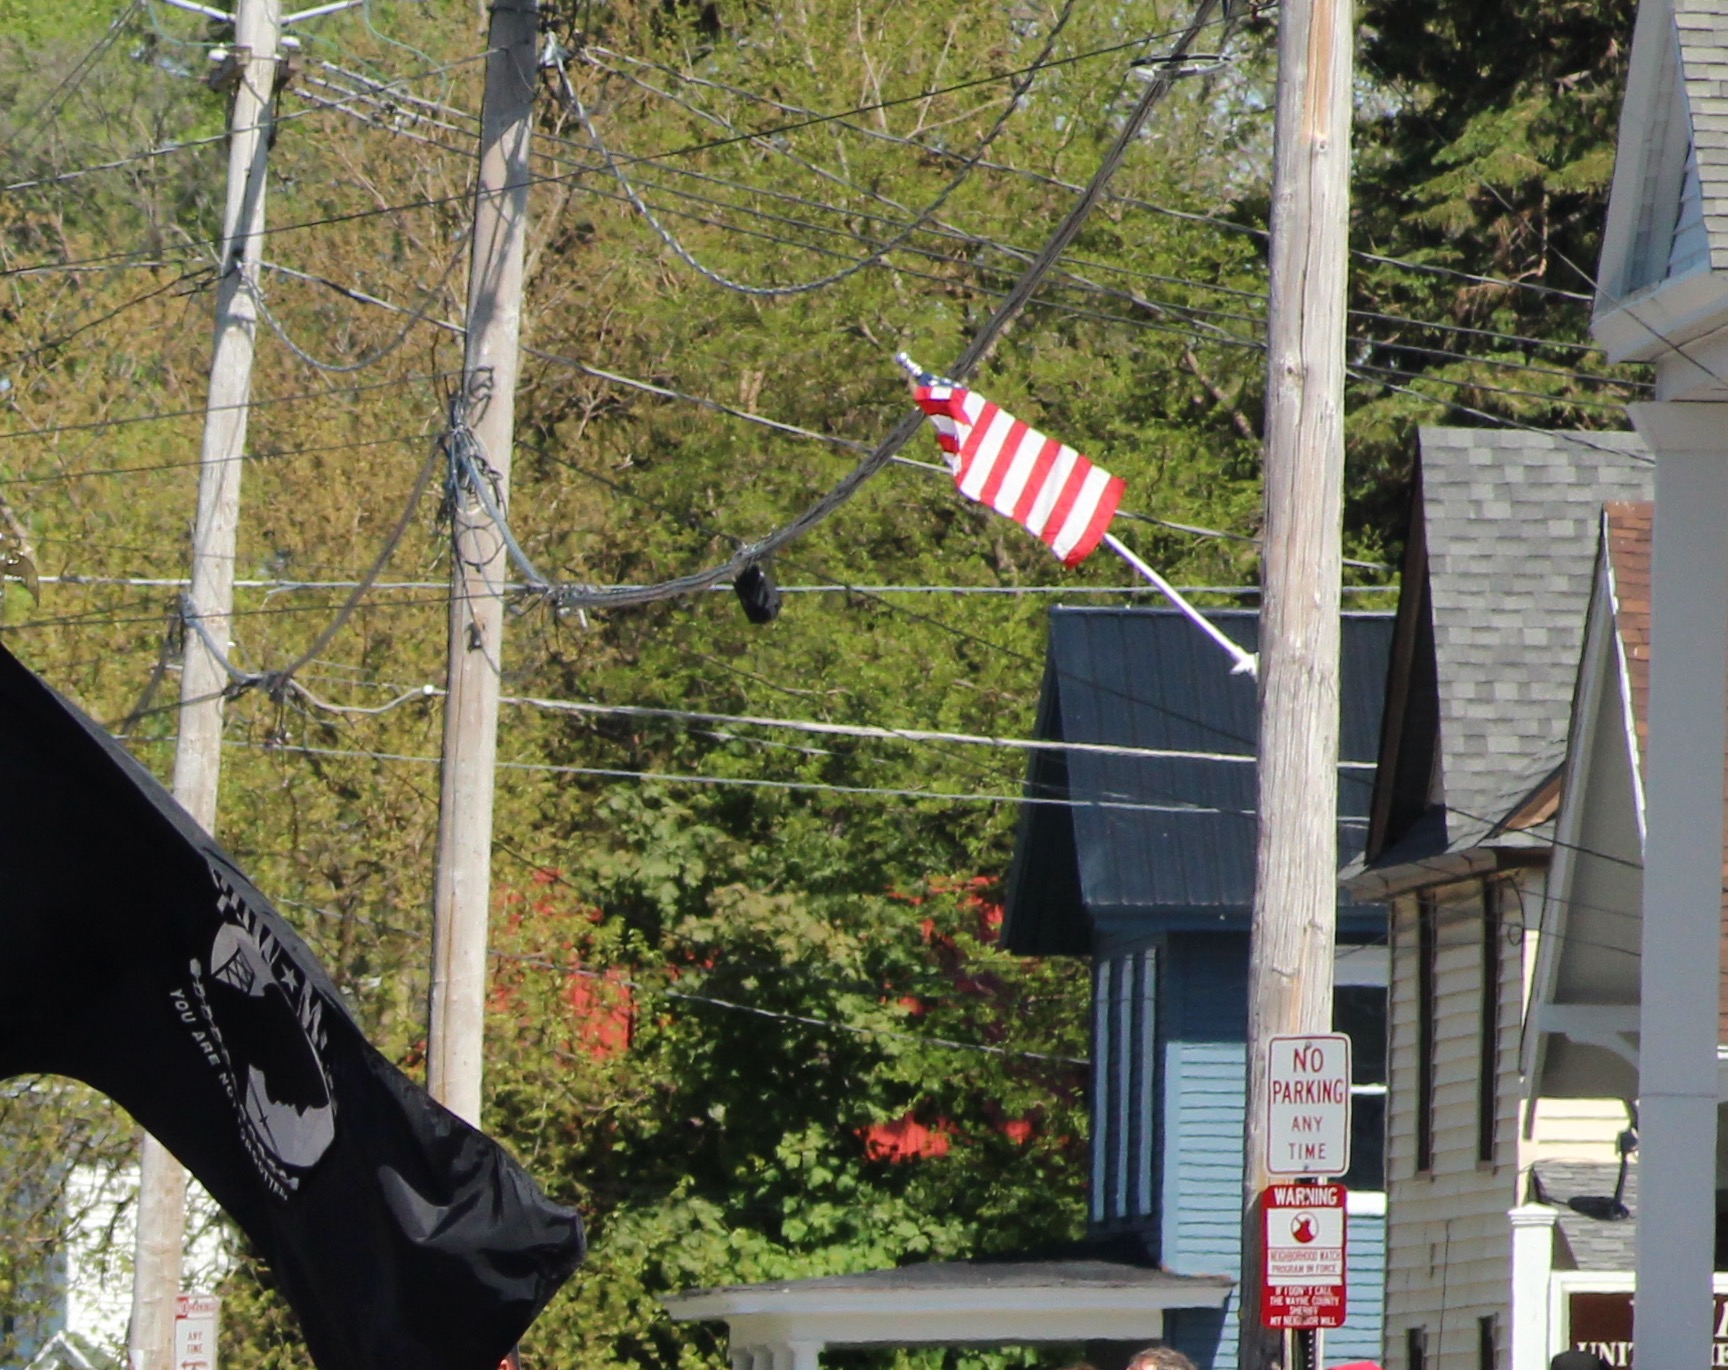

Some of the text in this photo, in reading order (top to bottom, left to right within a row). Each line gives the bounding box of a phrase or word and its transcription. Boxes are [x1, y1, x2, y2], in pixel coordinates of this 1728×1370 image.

[170, 988, 197, 1023] YOU
[192, 1031, 220, 1067] ARE
[1293, 1047, 1324, 1073] NO
[1272, 1080, 1344, 1105] PARKING
[1291, 1116, 1323, 1132] ANY
[1288, 1143, 1327, 1160] TIME
[1274, 1187, 1338, 1206] WARNING
